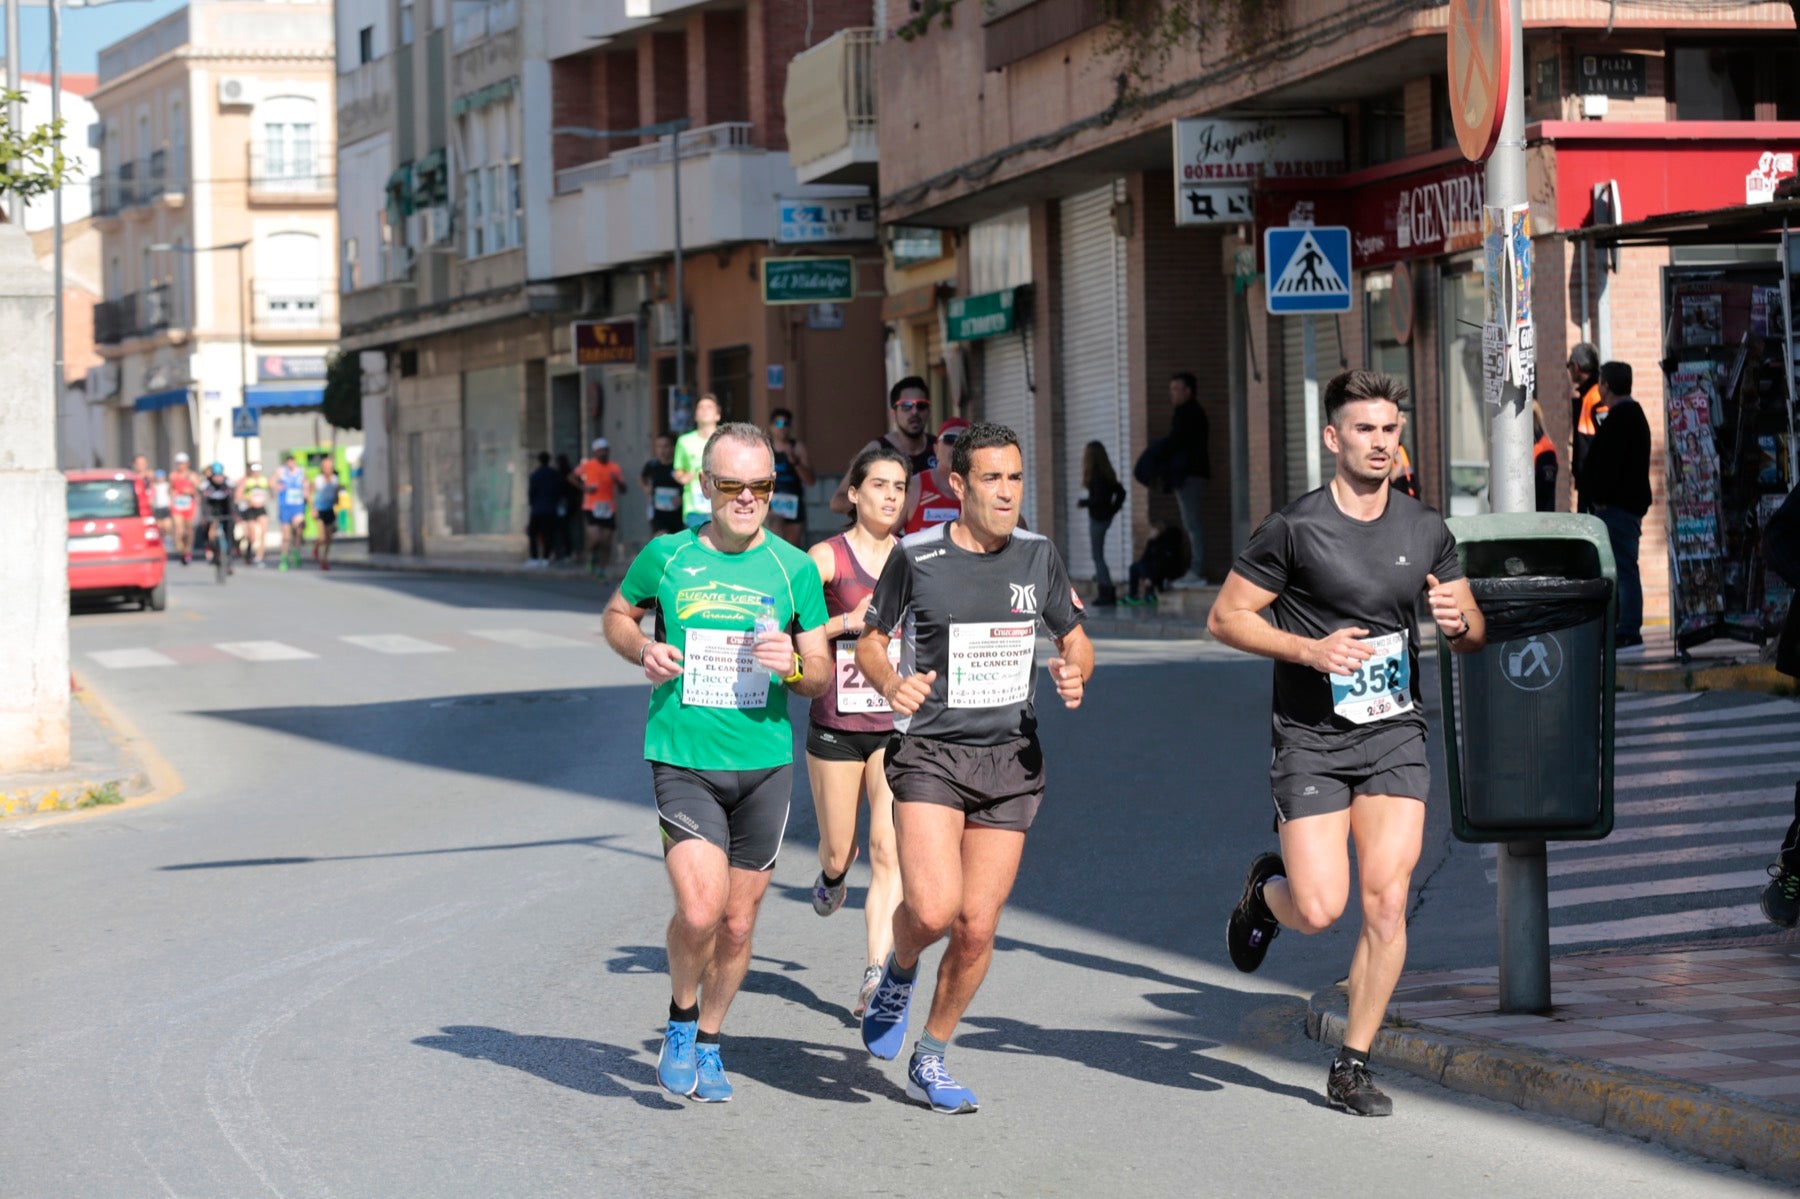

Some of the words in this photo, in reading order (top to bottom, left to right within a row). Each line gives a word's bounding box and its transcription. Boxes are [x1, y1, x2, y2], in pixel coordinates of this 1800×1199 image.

[1602, 58, 1632, 71] PLAZA
[1588, 78, 1638, 92] ANIMAS
[1411, 172, 1485, 245] GENERA
[678, 591, 726, 601] PUENTE
[702, 611, 744, 620] Granada
[967, 650, 998, 658] CORRO
[1000, 647, 1032, 657] CONTRA
[703, 655, 733, 663] CORRO
[718, 665, 753, 673] CANCER
[702, 675, 733, 684] aecc
[968, 672, 1000, 681] aecc
[1349, 659, 1400, 697] 352
